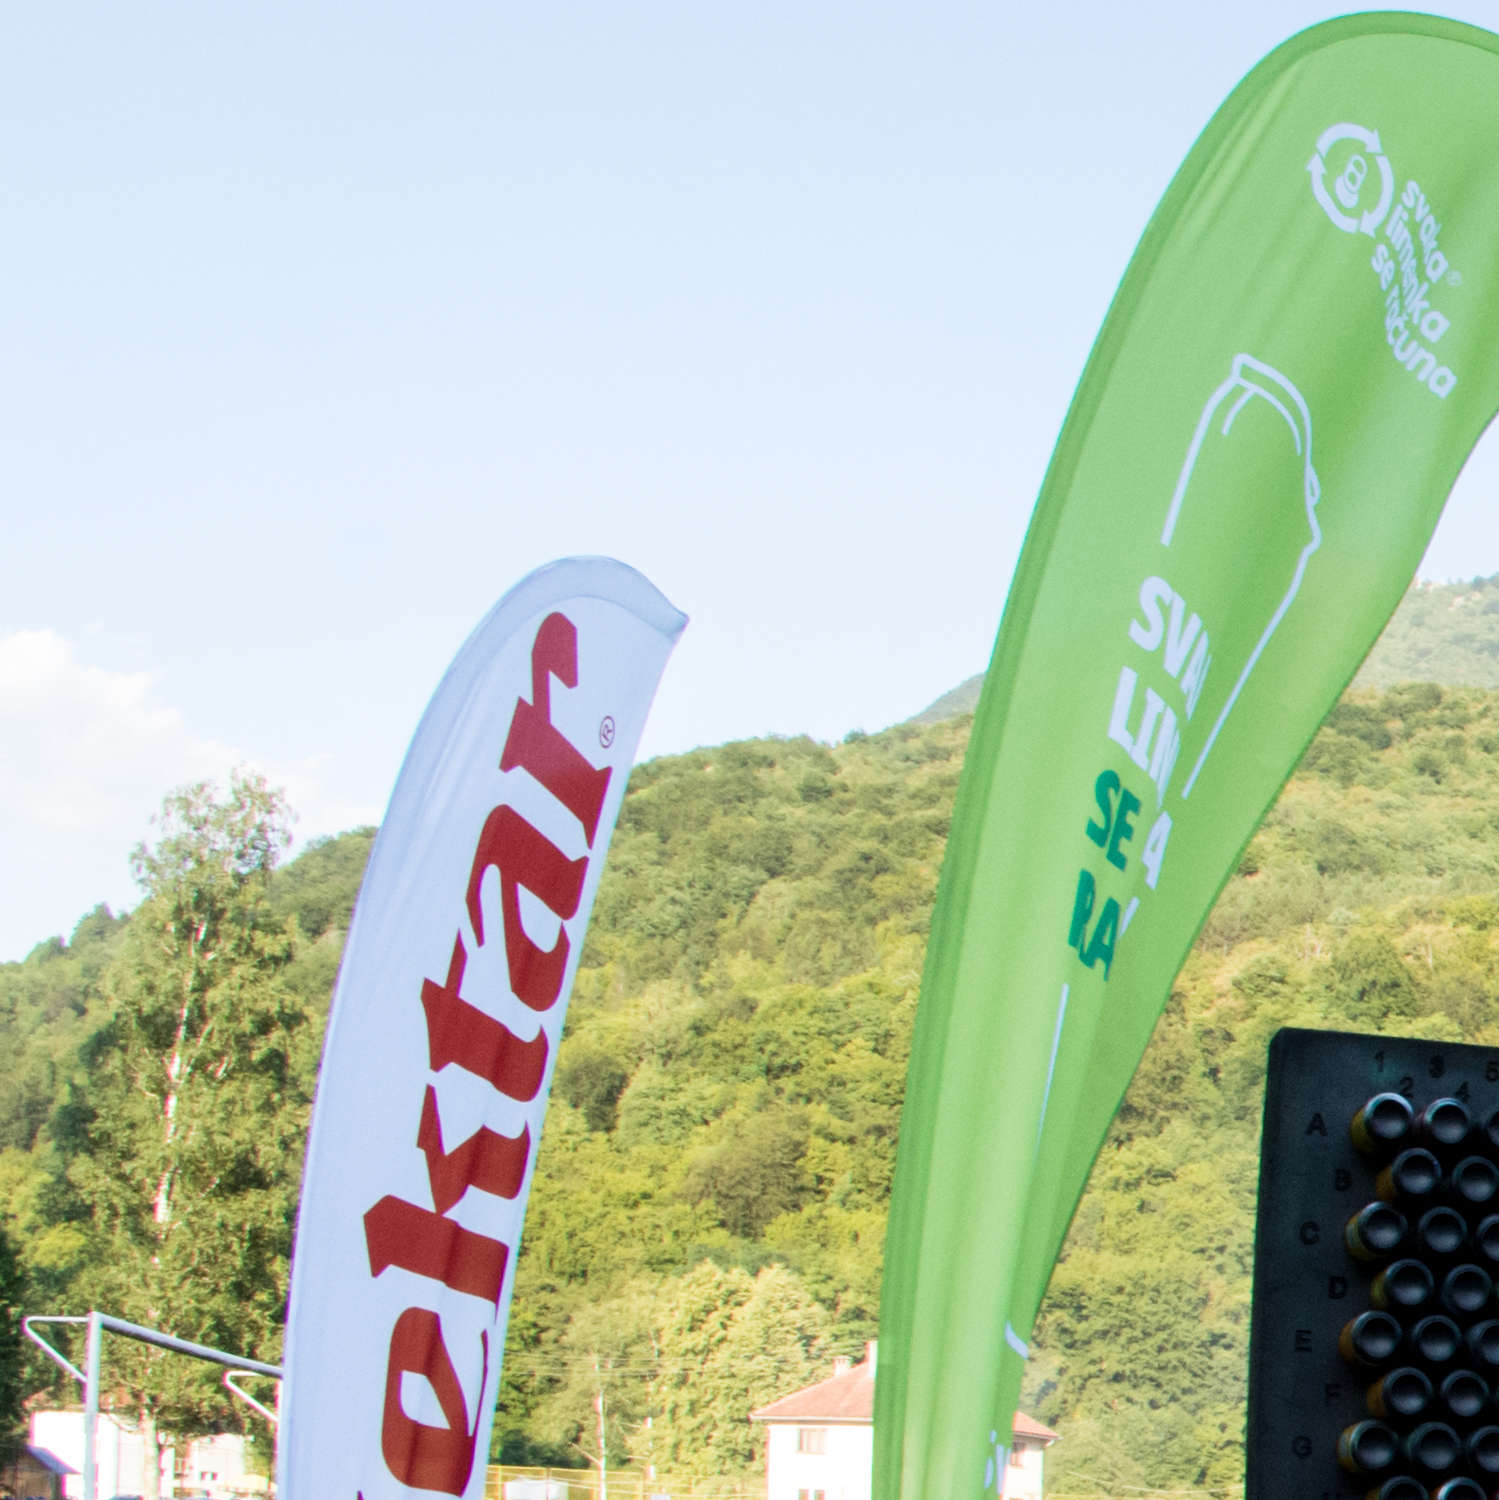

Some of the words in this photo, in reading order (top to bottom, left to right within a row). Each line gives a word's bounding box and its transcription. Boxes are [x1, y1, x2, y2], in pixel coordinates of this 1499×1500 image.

[1371, 243, 1395, 292] se
[1375, 1051, 1385, 1072] 1
[1429, 1055, 1444, 1078] 3
[1485, 1061, 1499, 1082] 5
[1399, 1077, 1414, 1098] 2
[1455, 1081, 1470, 1101] 4
[1307, 1113, 1326, 1136] A
[1335, 1169, 1350, 1192] B
[1299, 1221, 1319, 1245] C
[1328, 1276, 1348, 1299] D
[1294, 1329, 1312, 1352] E
[1325, 1383, 1340, 1406] F
[1292, 1435, 1312, 1460] G
